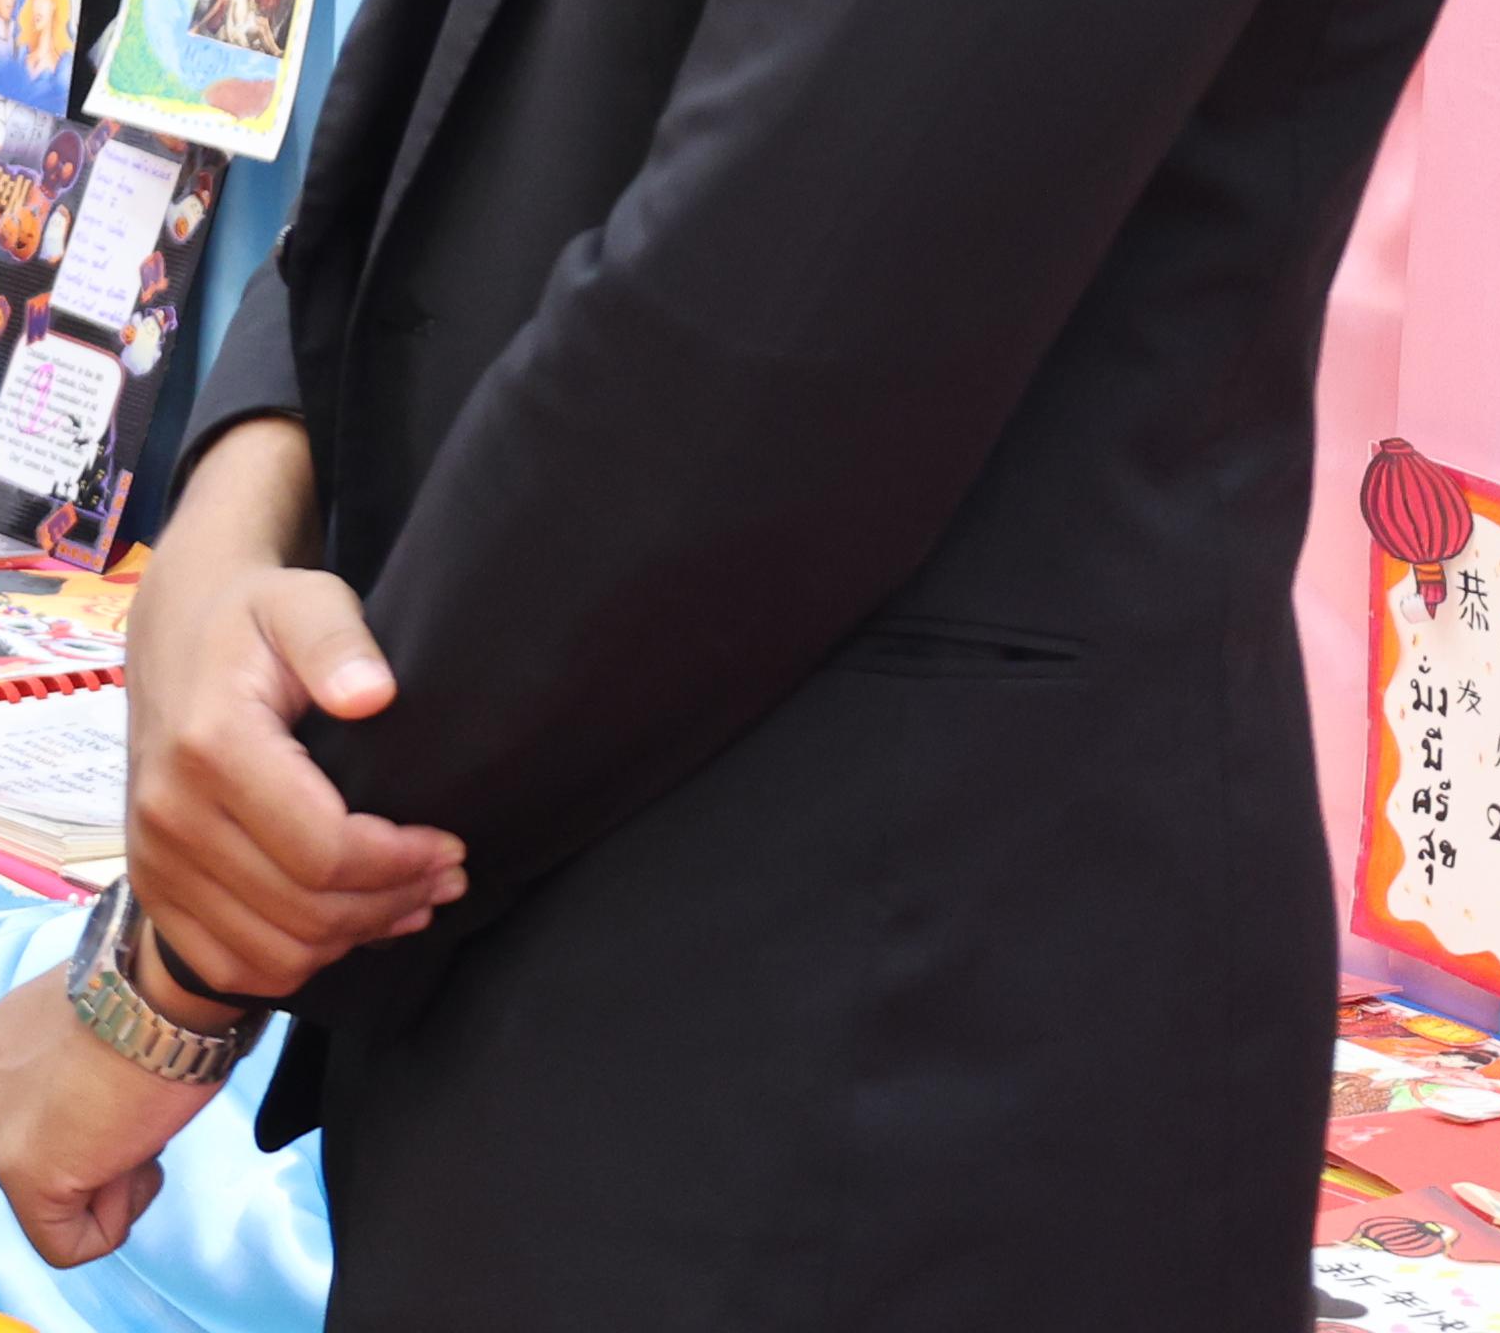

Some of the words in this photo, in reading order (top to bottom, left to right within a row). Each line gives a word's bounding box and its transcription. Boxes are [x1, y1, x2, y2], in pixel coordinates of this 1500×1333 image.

[1456, 569, 1490, 632] 恭
[1456, 678, 1482, 716] 发
[1421, 726, 1443, 771] มี
[1412, 778, 1451, 823] ศรี
